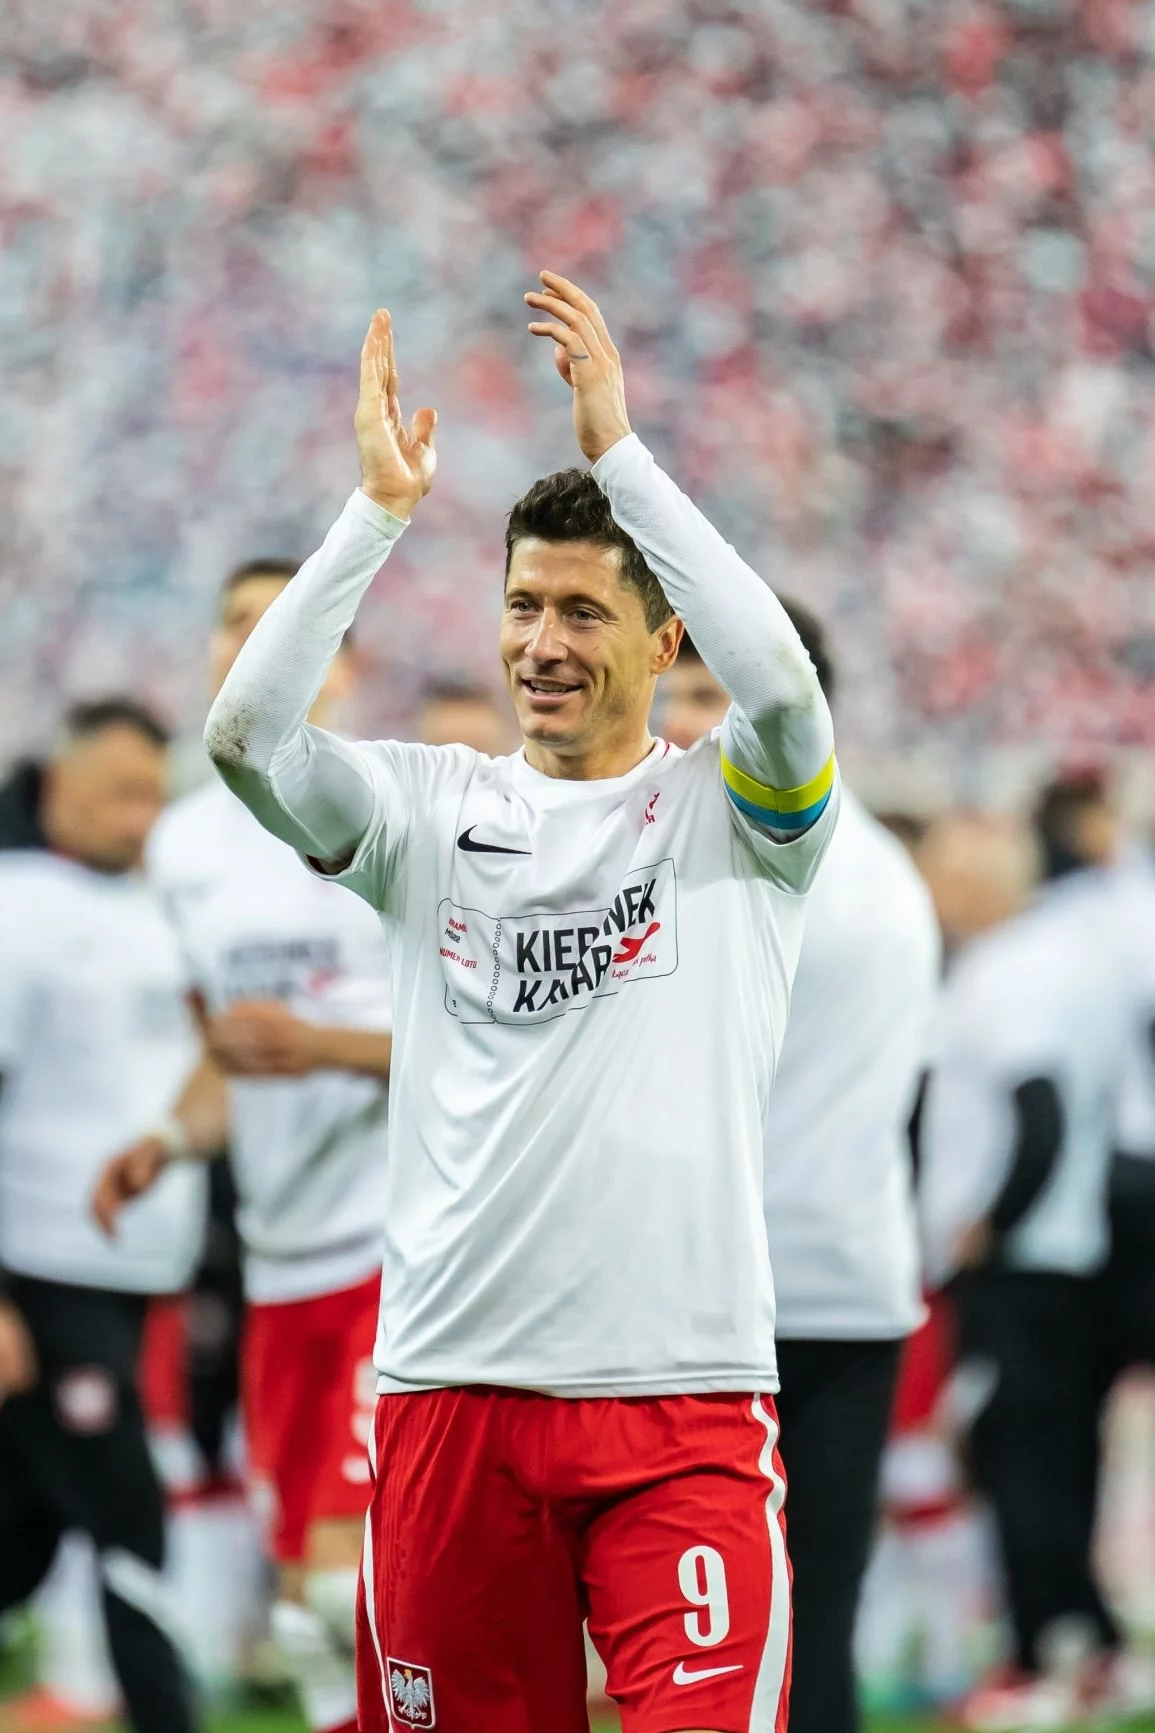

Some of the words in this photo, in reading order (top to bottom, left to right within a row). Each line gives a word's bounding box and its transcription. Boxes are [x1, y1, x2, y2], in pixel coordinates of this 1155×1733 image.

[517, 879, 656, 972] KIERNEK
[513, 945, 612, 1012] KAAR
[677, 1545, 730, 1647] 9
